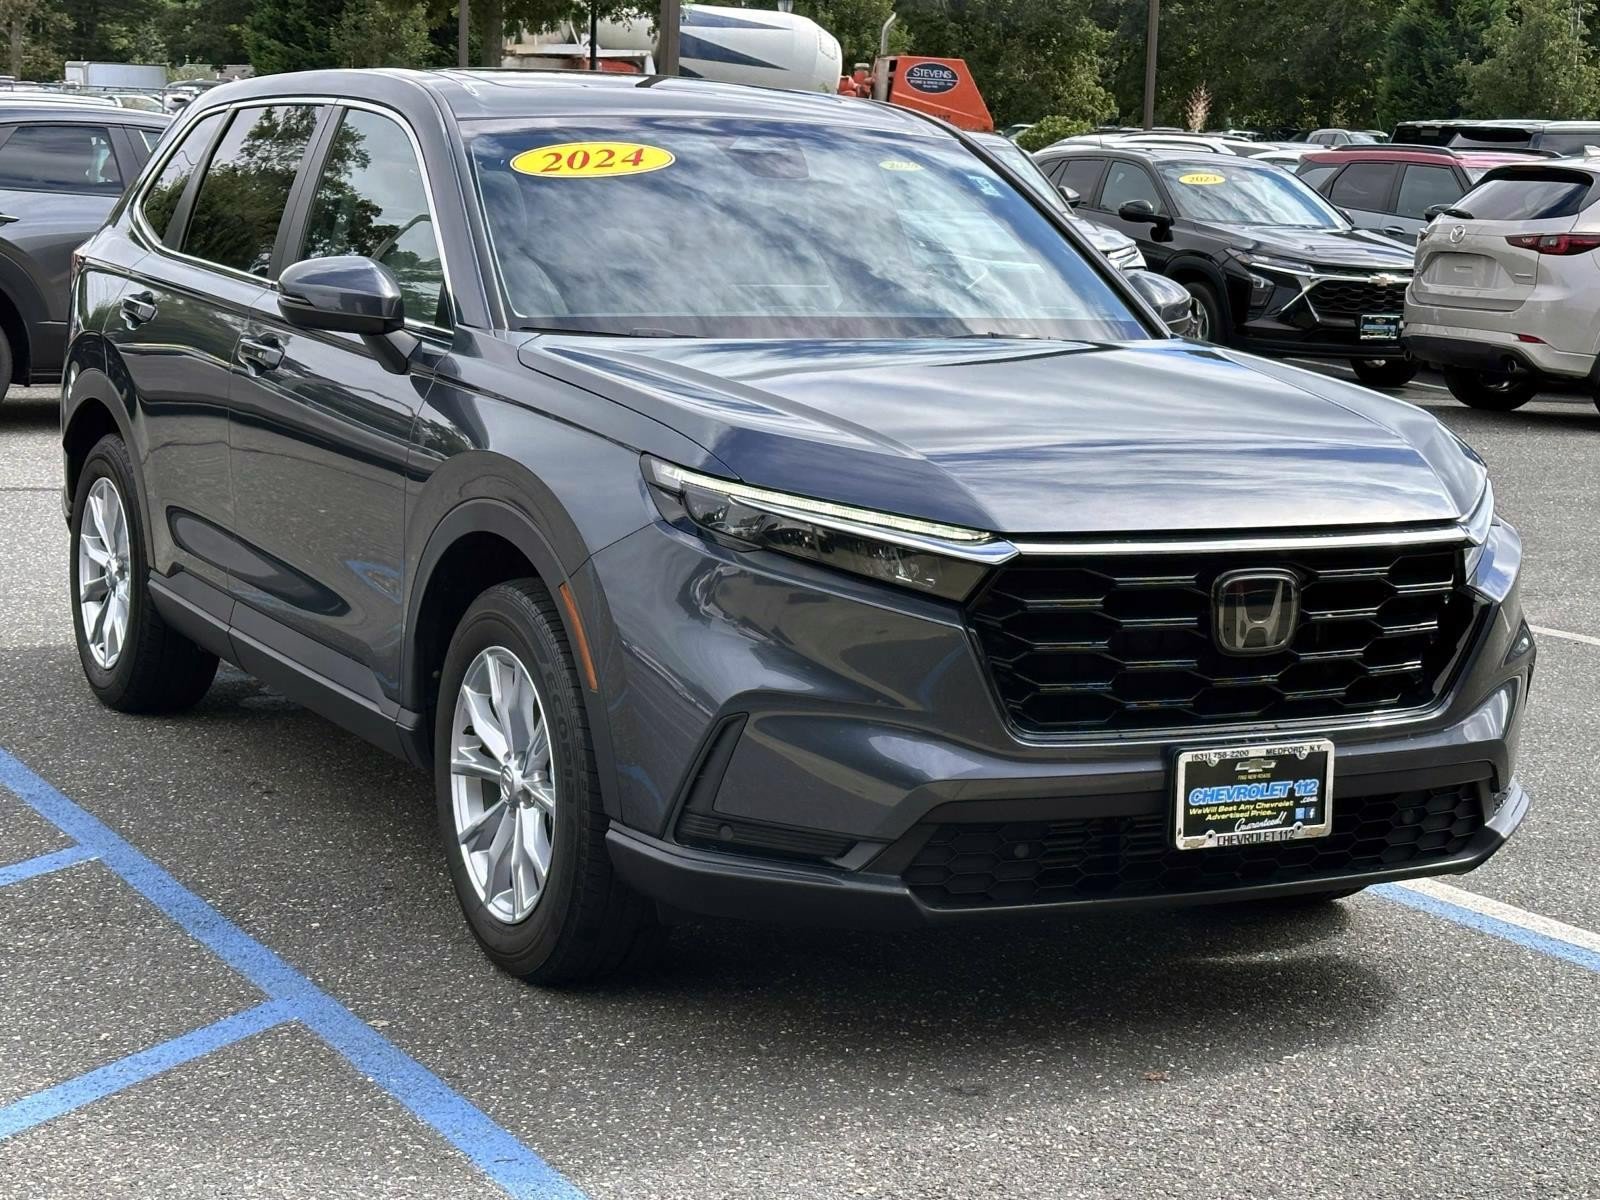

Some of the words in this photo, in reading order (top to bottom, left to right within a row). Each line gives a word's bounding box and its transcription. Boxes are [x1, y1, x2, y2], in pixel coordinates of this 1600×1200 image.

[913, 67, 952, 80] STEVENS
[540, 148, 645, 173] 2024
[1213, 750, 1249, 760] 758-2200
[1189, 781, 1293, 805] CHEVROLET
[1294, 778, 1319, 797] 112
[1238, 803, 1255, 811] Any
[1255, 800, 1294, 809] Chevrolet
[1205, 811, 1250, 821] Advertised
[1217, 831, 1275, 845] CHEVROLET
[1279, 829, 1295, 841] 112
